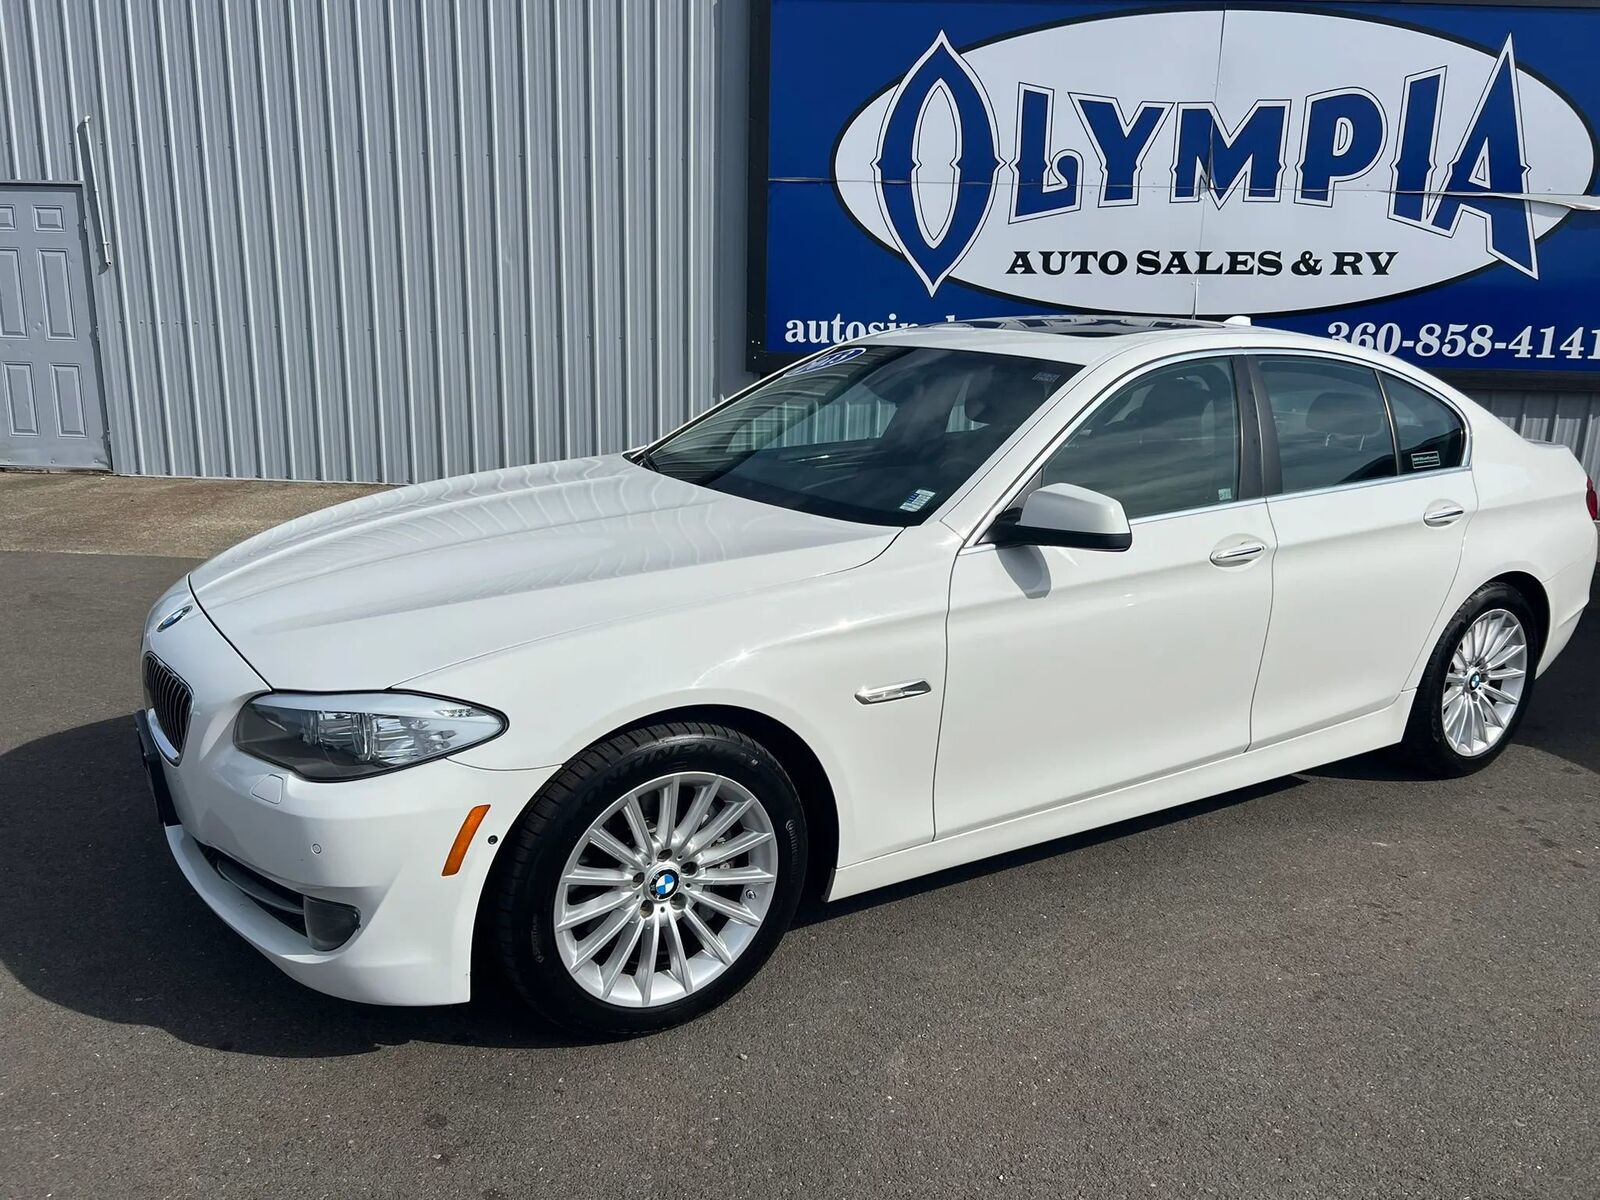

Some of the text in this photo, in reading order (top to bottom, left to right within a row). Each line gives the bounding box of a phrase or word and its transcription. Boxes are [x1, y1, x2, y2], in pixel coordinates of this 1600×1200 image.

[870, 29, 1540, 298] OLYMPIA
[1005, 250, 1399, 276] AUTO SALES & RV
